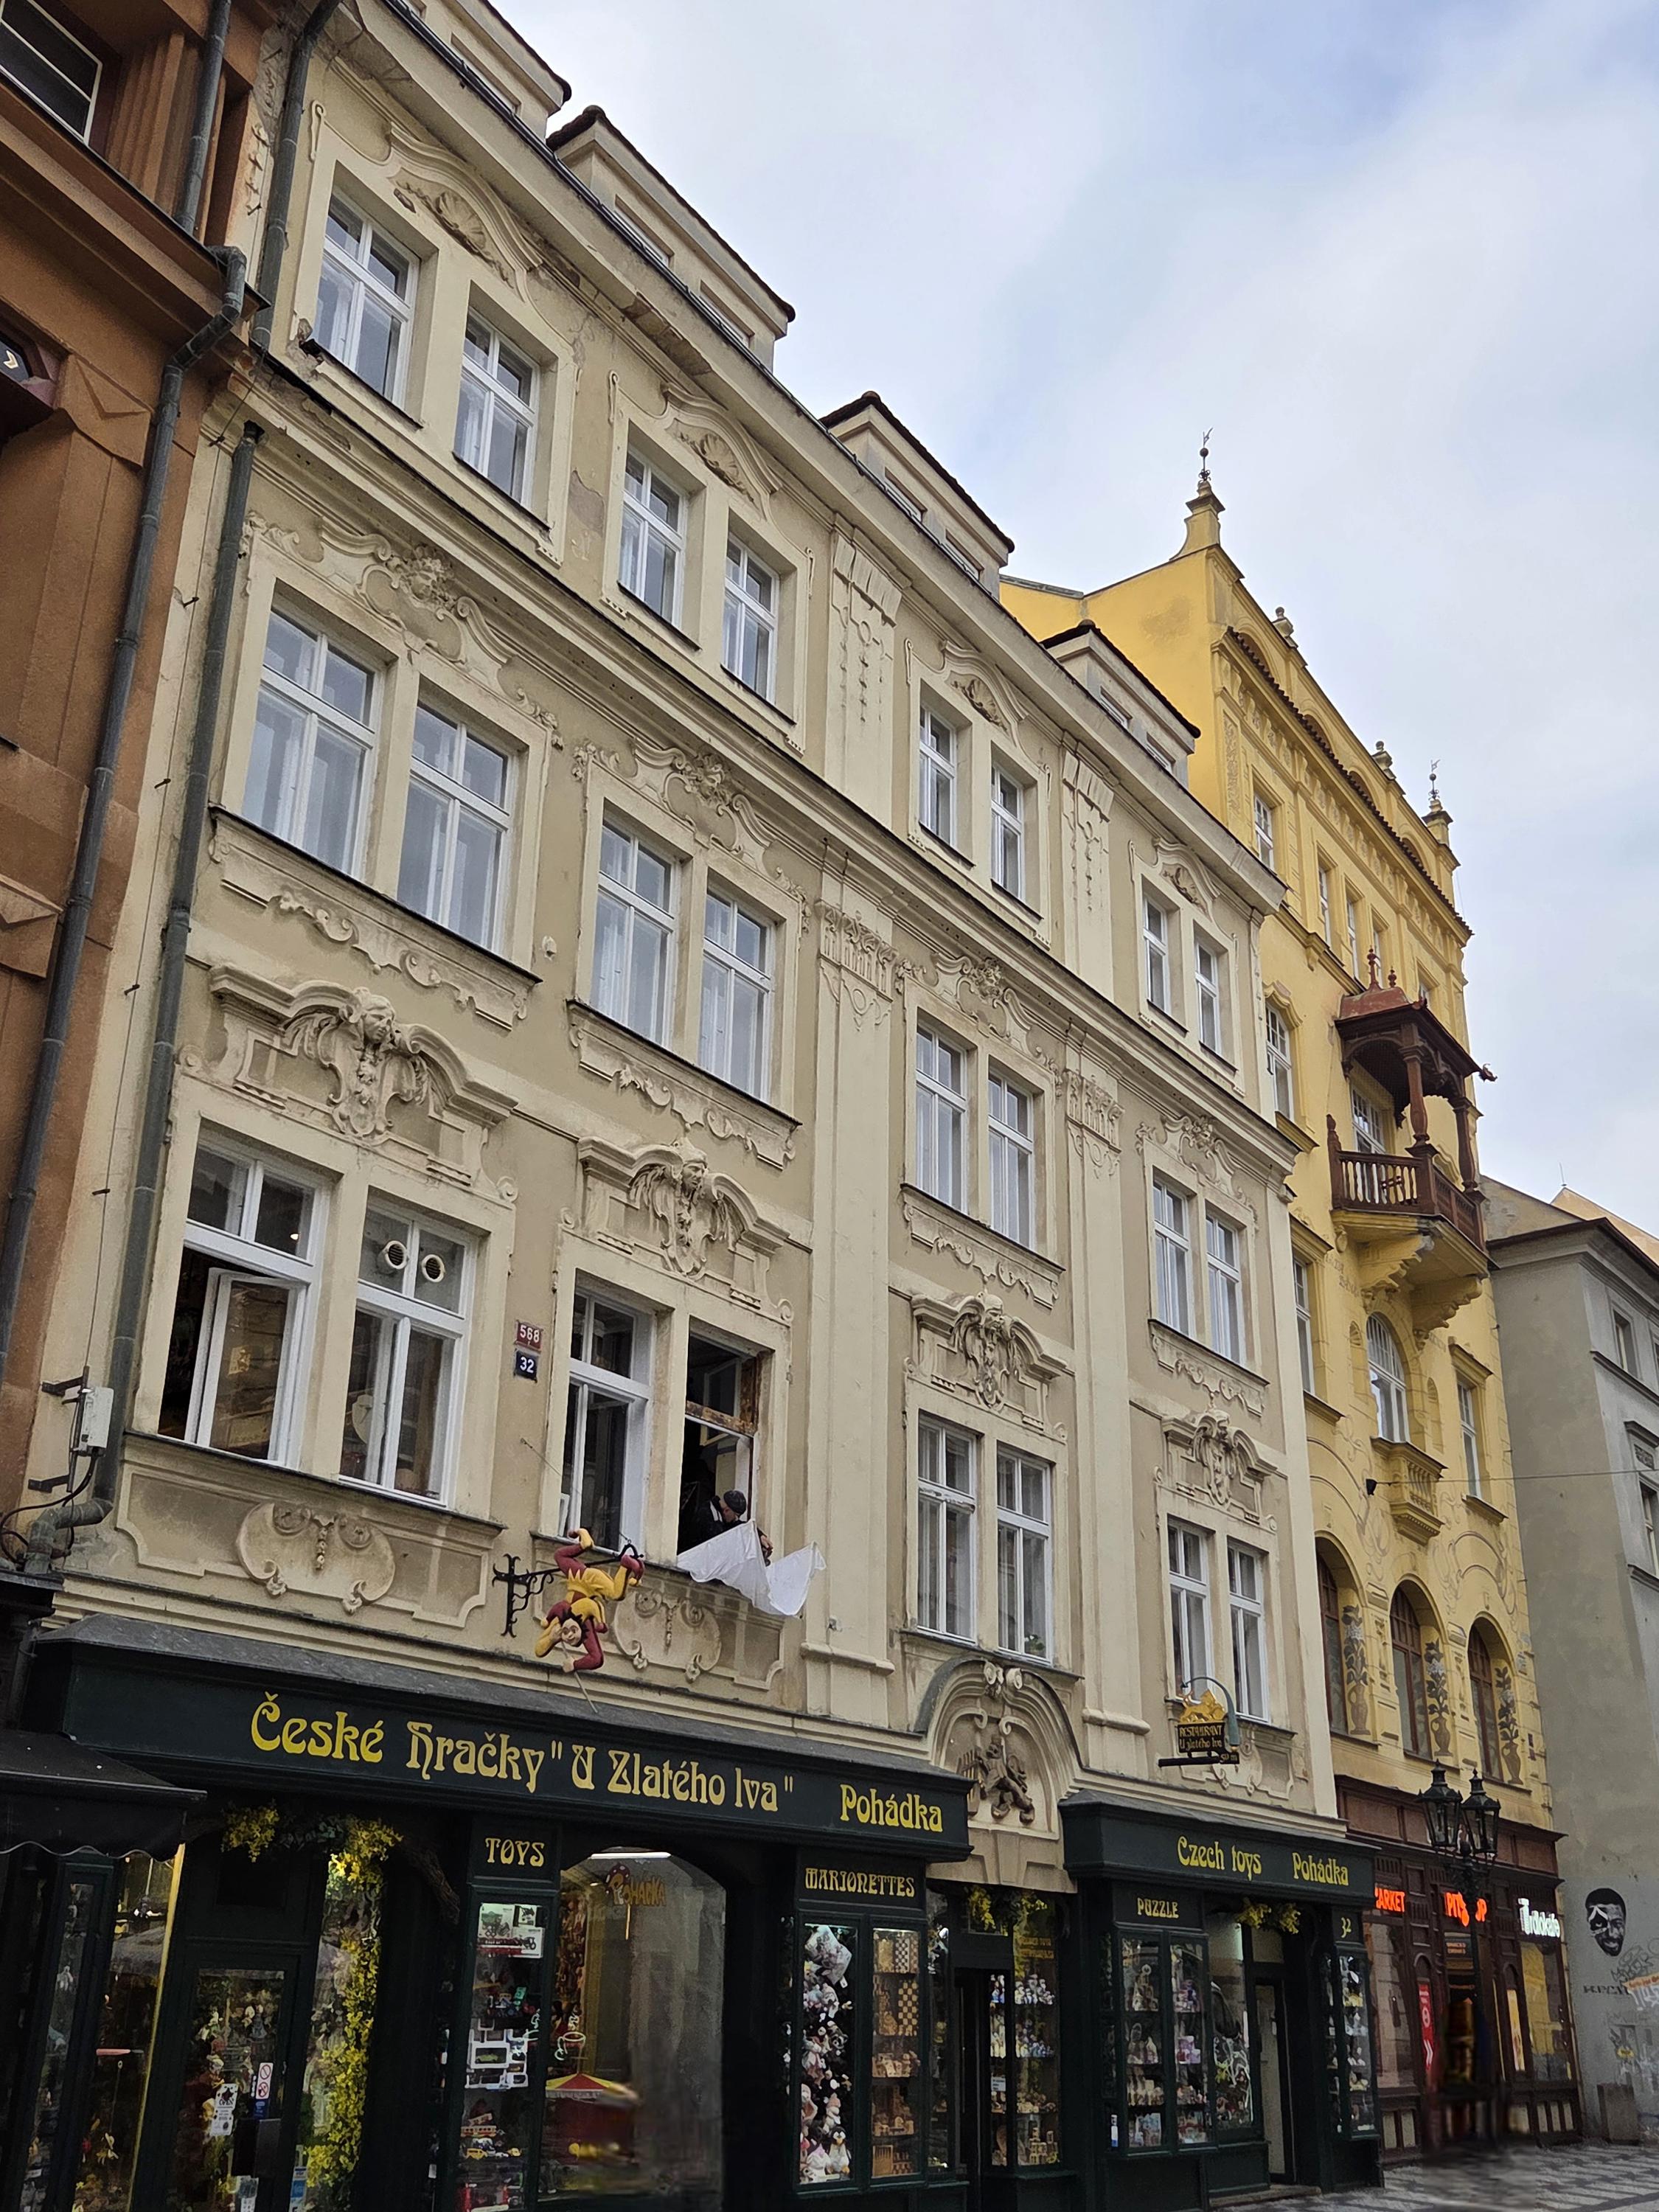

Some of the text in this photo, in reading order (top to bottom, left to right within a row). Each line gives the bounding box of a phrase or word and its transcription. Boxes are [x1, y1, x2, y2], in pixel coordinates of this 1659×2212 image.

[520, 1324, 540, 1343] 568
[520, 1356, 535, 1373] 32
[251, 1692, 384, 1764] České
[407, 1721, 545, 1792] Hračky
[608, 1750, 726, 1806] Zlatého
[1180, 1739, 1185, 1749] U
[839, 1784, 943, 1833] Pohádka
[485, 1837, 545, 1867] TOYS
[1178, 1836, 1262, 1881] Czech toys
[804, 1867, 916, 1898] MARIONETTES
[1292, 1851, 1349, 1886] Pohádka
[1137, 1897, 1179, 1919] PUZZLE
[1374, 1887, 1405, 1913] ARKET
[1340, 1917, 1352, 1938] 32
